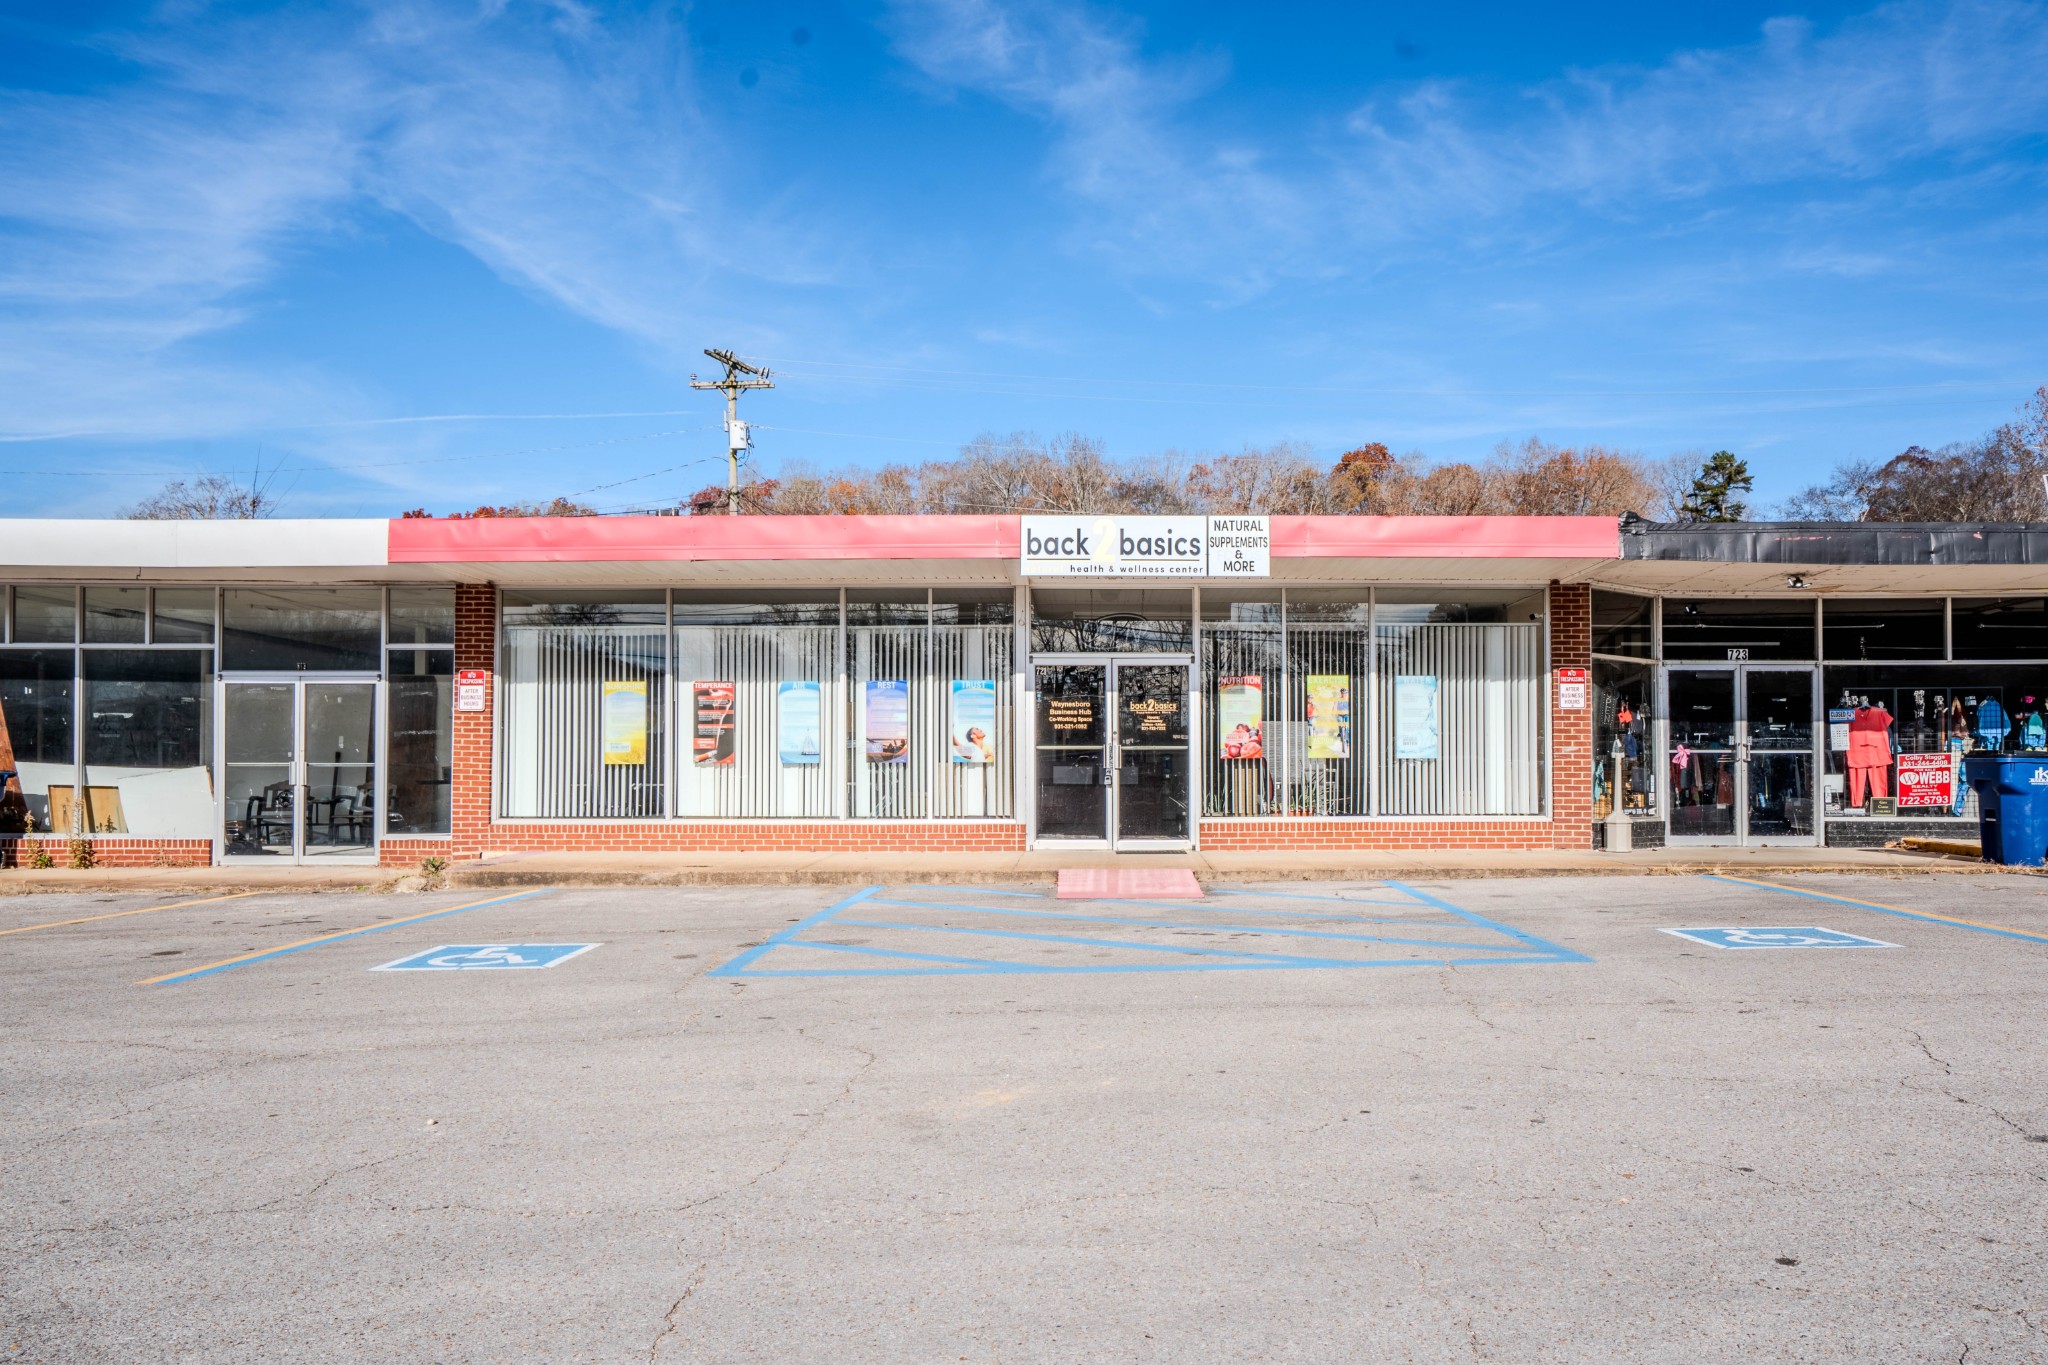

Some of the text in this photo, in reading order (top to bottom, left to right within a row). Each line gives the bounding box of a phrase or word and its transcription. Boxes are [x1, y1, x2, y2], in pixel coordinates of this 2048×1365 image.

[1214, 520, 1264, 531] NATURAL
[1027, 519, 1201, 562] back 2 basics
[1210, 537, 1268, 548] SUPPLEMENTS
[1235, 550, 1243, 559] &
[1070, 565, 1104, 573] health
[1108, 565, 1114, 573] &
[1119, 565, 1165, 573] wellness
[1223, 561, 1255, 572] MORE
[1728, 649, 1748, 660] 723
[793, 682, 806, 690] AIR
[962, 681, 986, 689] TRUST
[1221, 677, 1261, 685] NUTRITION
[1919, 770, 1950, 784] WEBB
[1901, 796, 1949, 805] 722-5793
